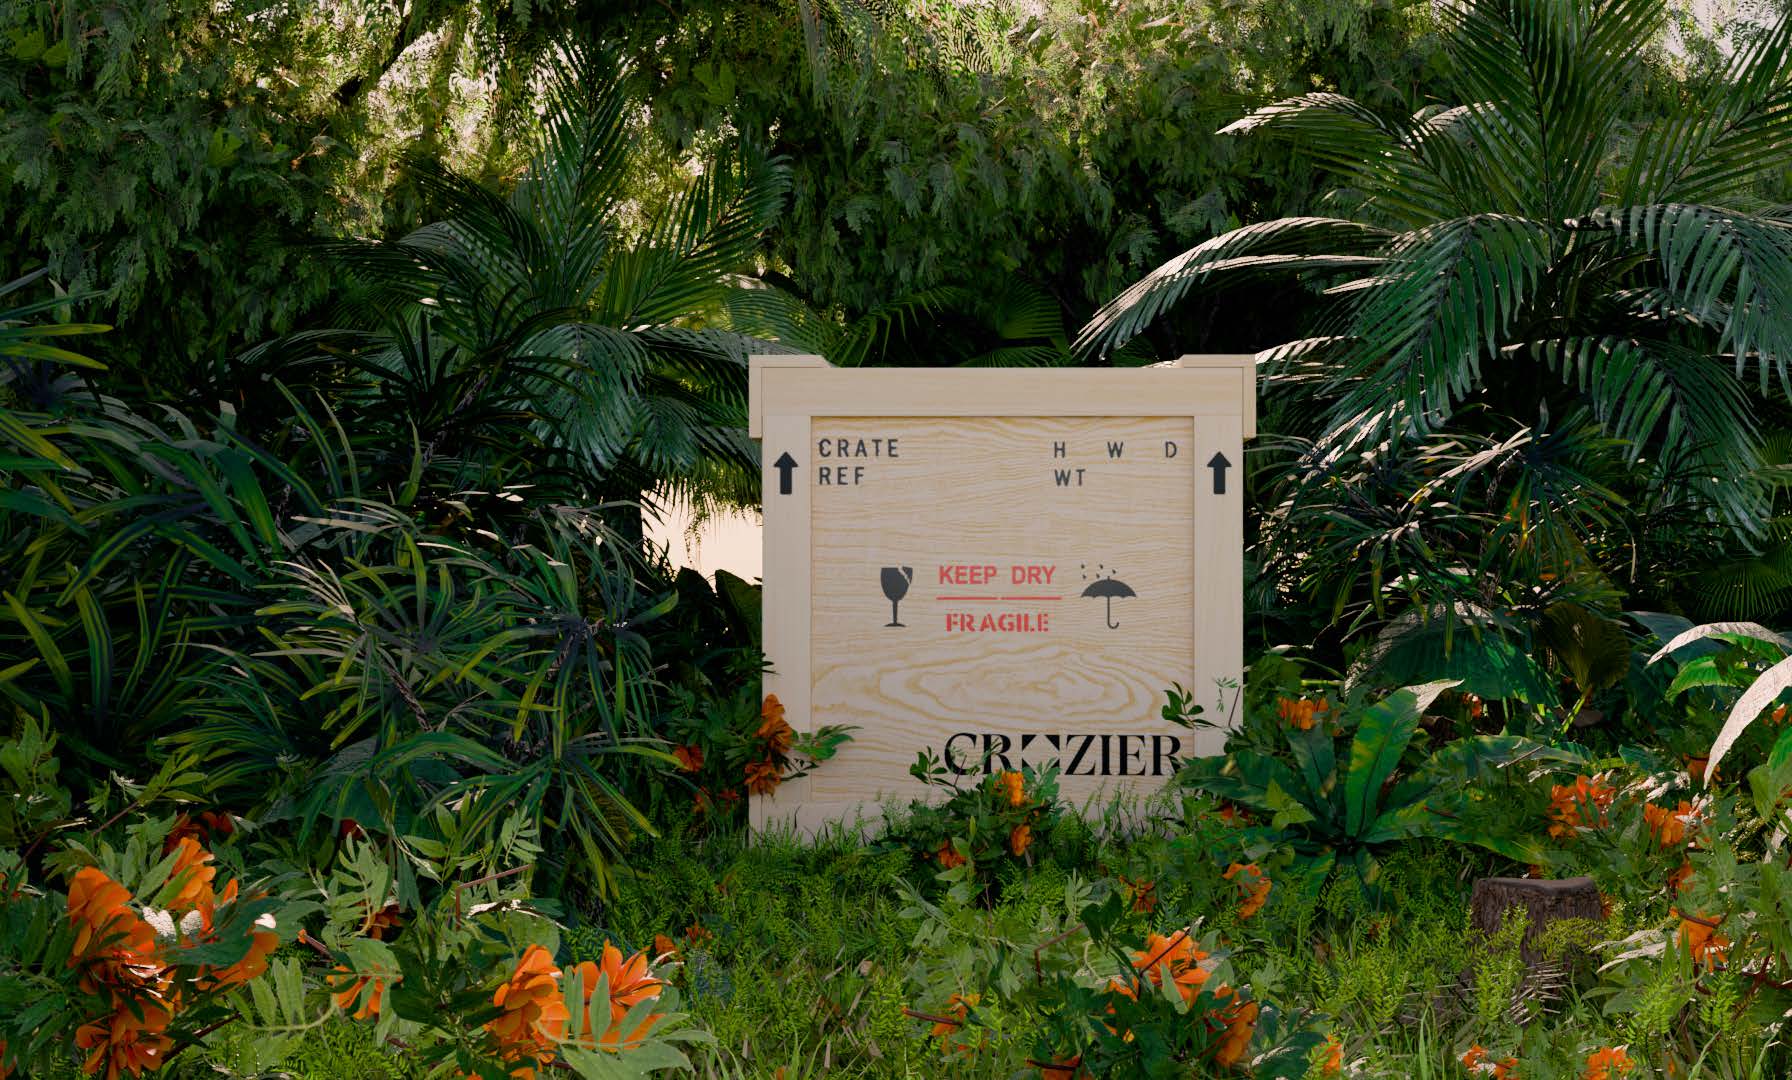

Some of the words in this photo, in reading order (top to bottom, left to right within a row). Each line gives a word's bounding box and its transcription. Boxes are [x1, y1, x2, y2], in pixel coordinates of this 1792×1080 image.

[817, 438, 899, 458] CRATE
[1053, 441, 1066, 459] H
[1107, 441, 1124, 459] W
[1165, 441, 1178, 459] D
[818, 466, 865, 486] REF
[1054, 468, 1086, 487] WT
[939, 565, 998, 585] KEEP
[1011, 565, 1056, 585] DRY
[945, 613, 1049, 633] FRAGILE
